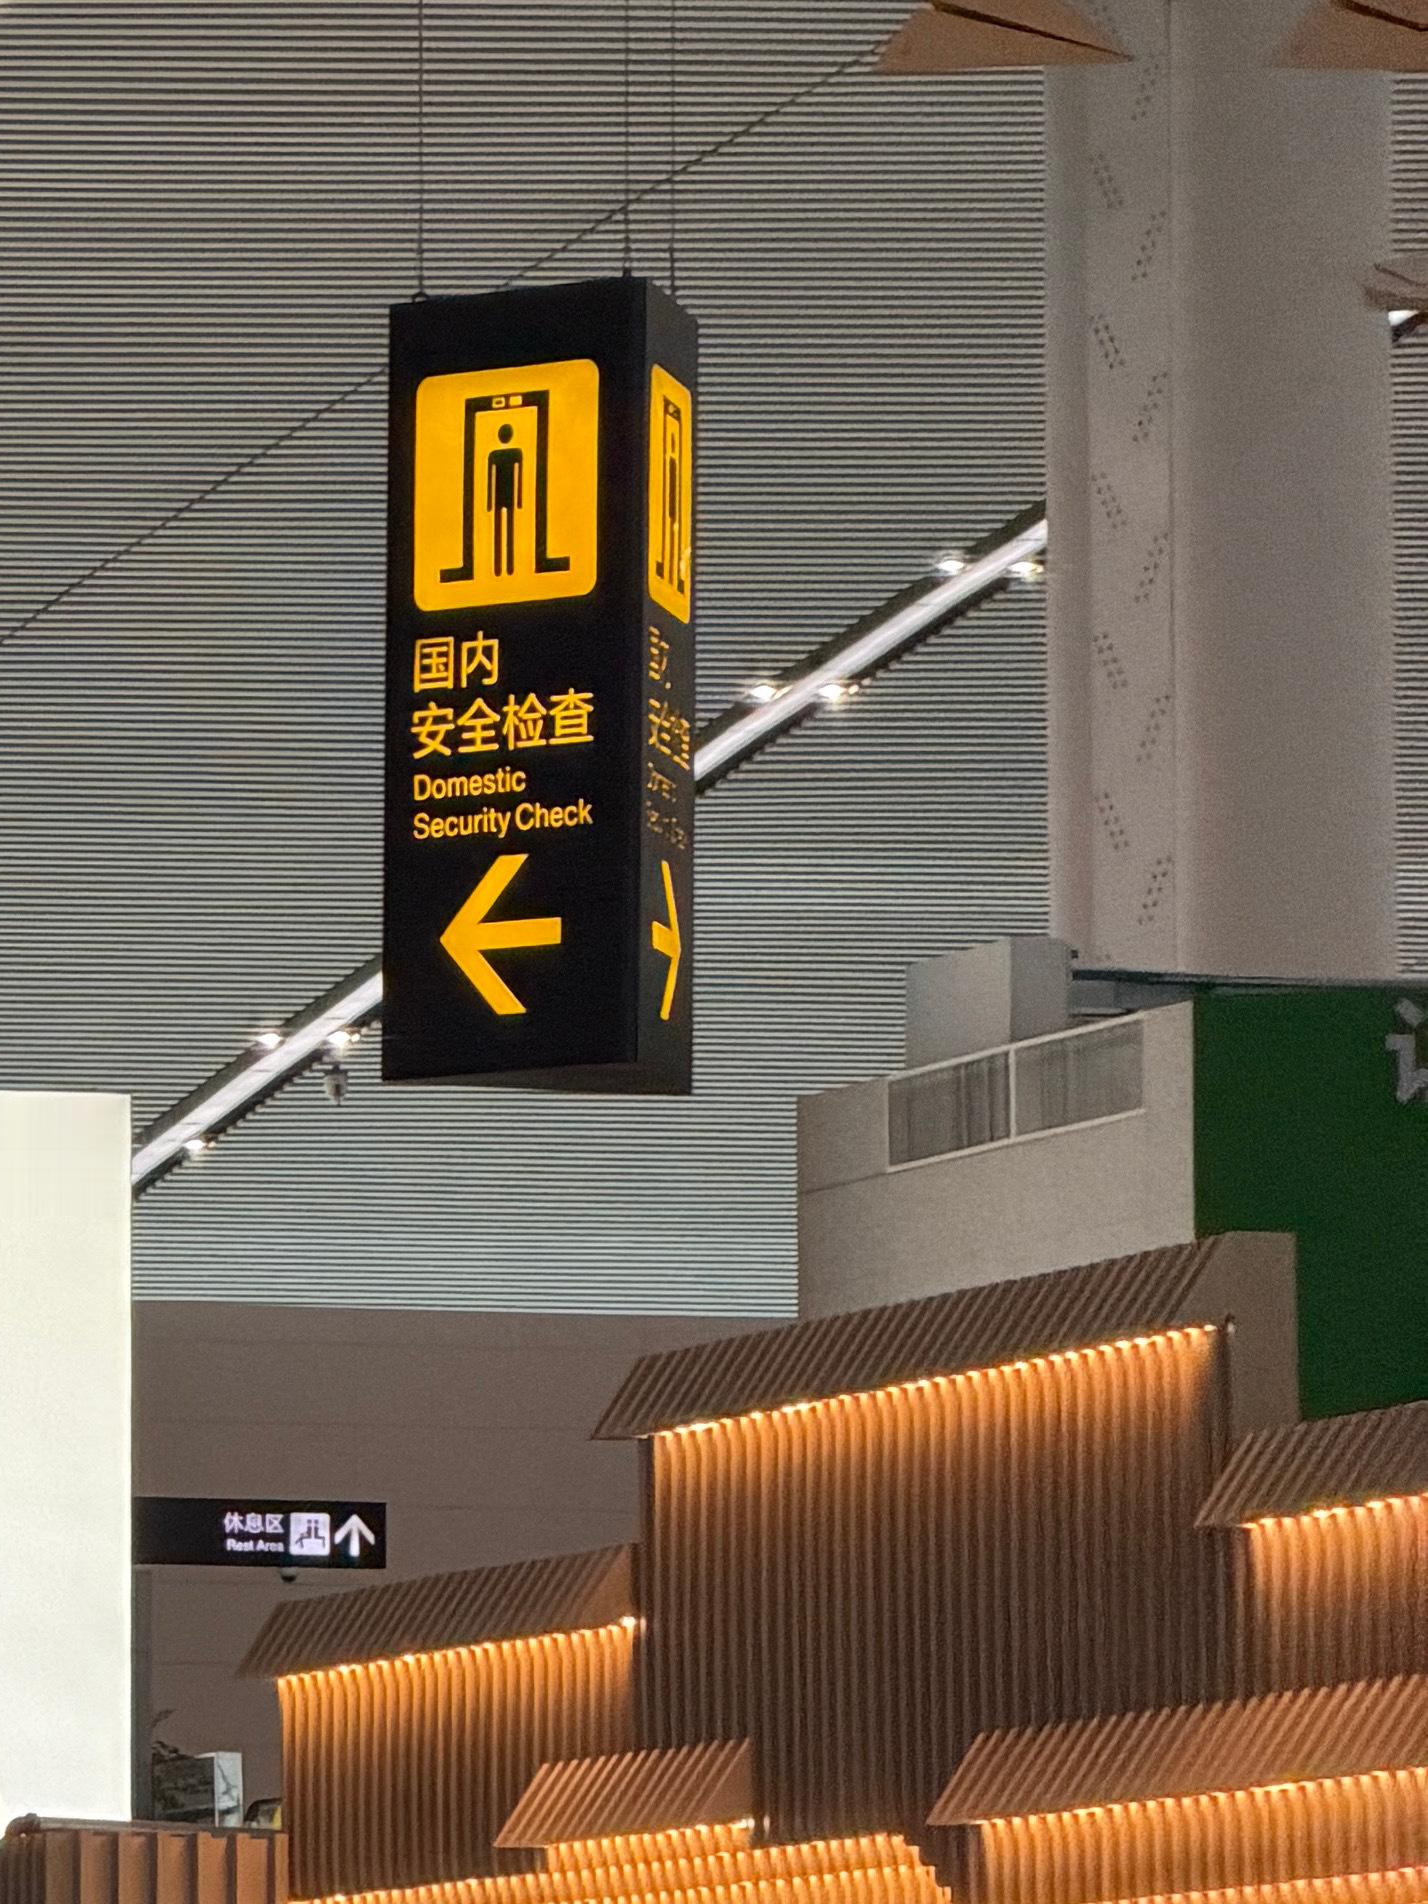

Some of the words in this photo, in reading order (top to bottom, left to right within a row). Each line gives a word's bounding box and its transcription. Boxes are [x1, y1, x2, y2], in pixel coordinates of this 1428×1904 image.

[413, 630, 499, 693] 国内
[411, 688, 595, 761] 安全检查
[413, 767, 526, 802] Domestic
[413, 807, 511, 841] Security
[515, 798, 593, 831] Check
[223, 1511, 285, 1534] 休息区
